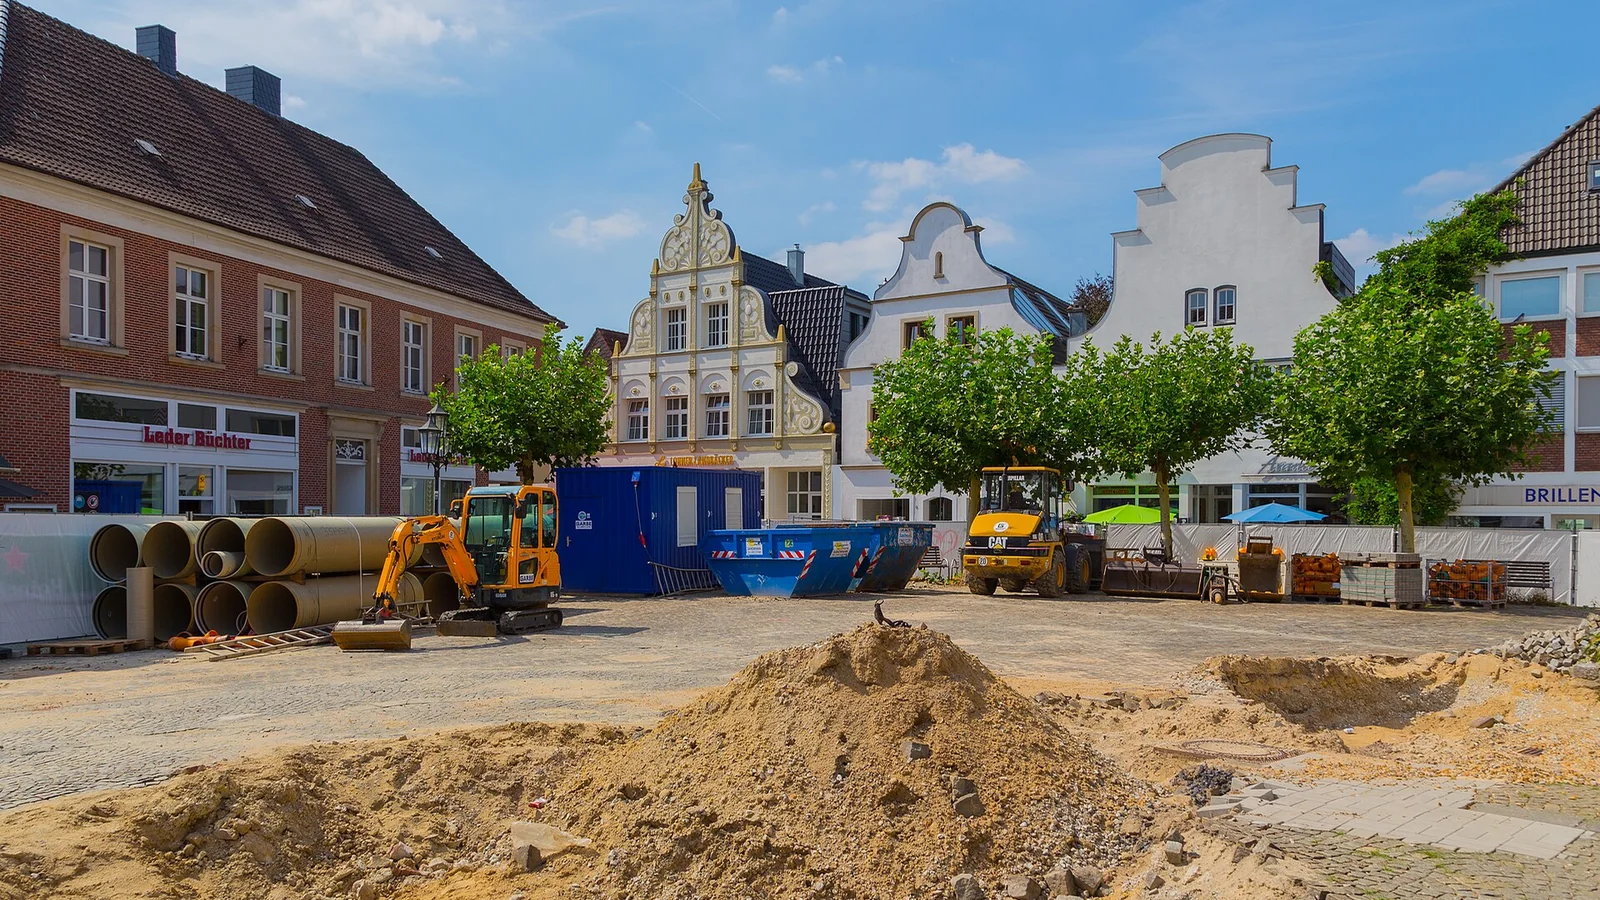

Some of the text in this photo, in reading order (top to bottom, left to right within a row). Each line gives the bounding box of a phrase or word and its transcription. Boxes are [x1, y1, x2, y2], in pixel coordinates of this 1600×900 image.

[143, 426, 252, 449] Leder Büchter
[1525, 487, 1600, 503] BRILLEN
[988, 536, 1008, 549] CAT
